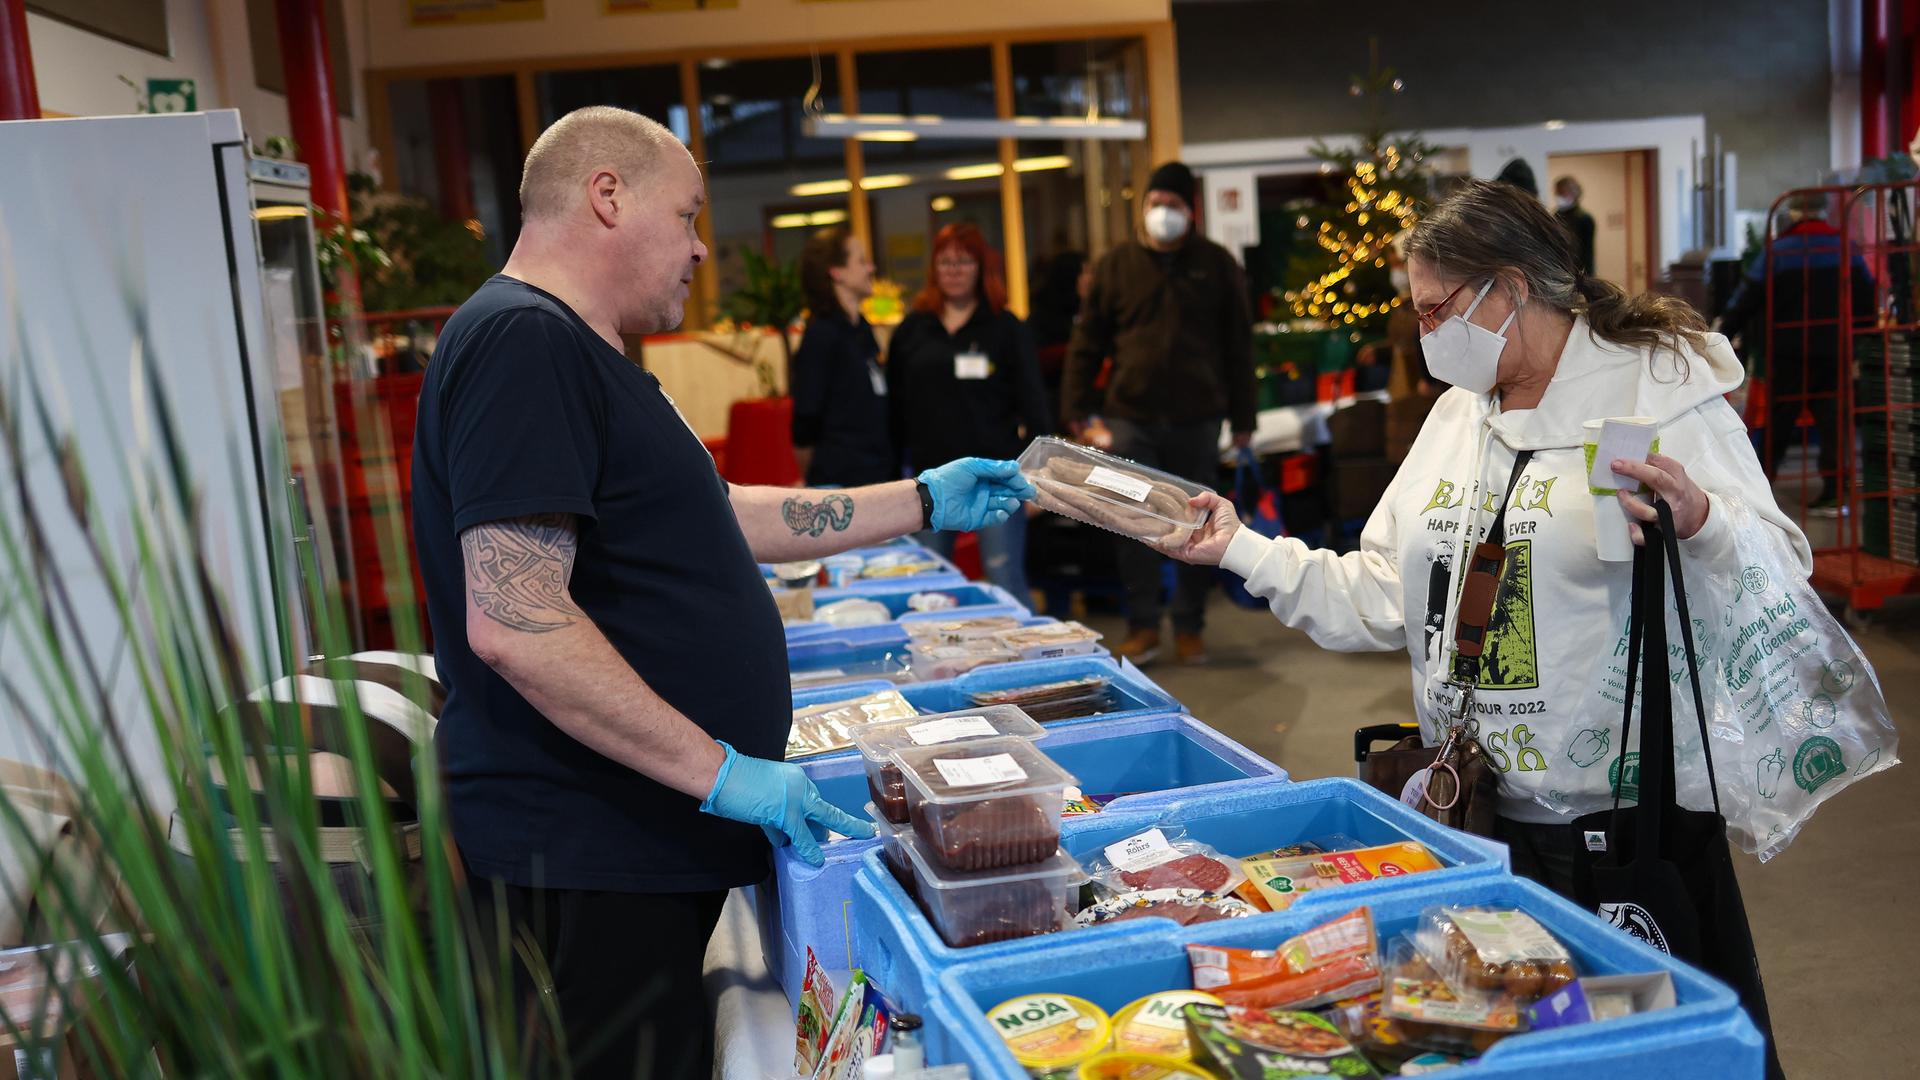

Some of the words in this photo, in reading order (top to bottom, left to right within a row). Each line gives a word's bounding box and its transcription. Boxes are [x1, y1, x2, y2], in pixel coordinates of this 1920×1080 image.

[1427, 518, 1486, 539] HAPPER
[1509, 521, 1537, 537] EVER
[1763, 592, 1797, 622] trägt
[1762, 618, 1809, 655] Gemüse
[1472, 702, 1503, 715] TOUR
[1509, 701, 1546, 715] 2022
[1148, 1000, 1187, 1021] NO
